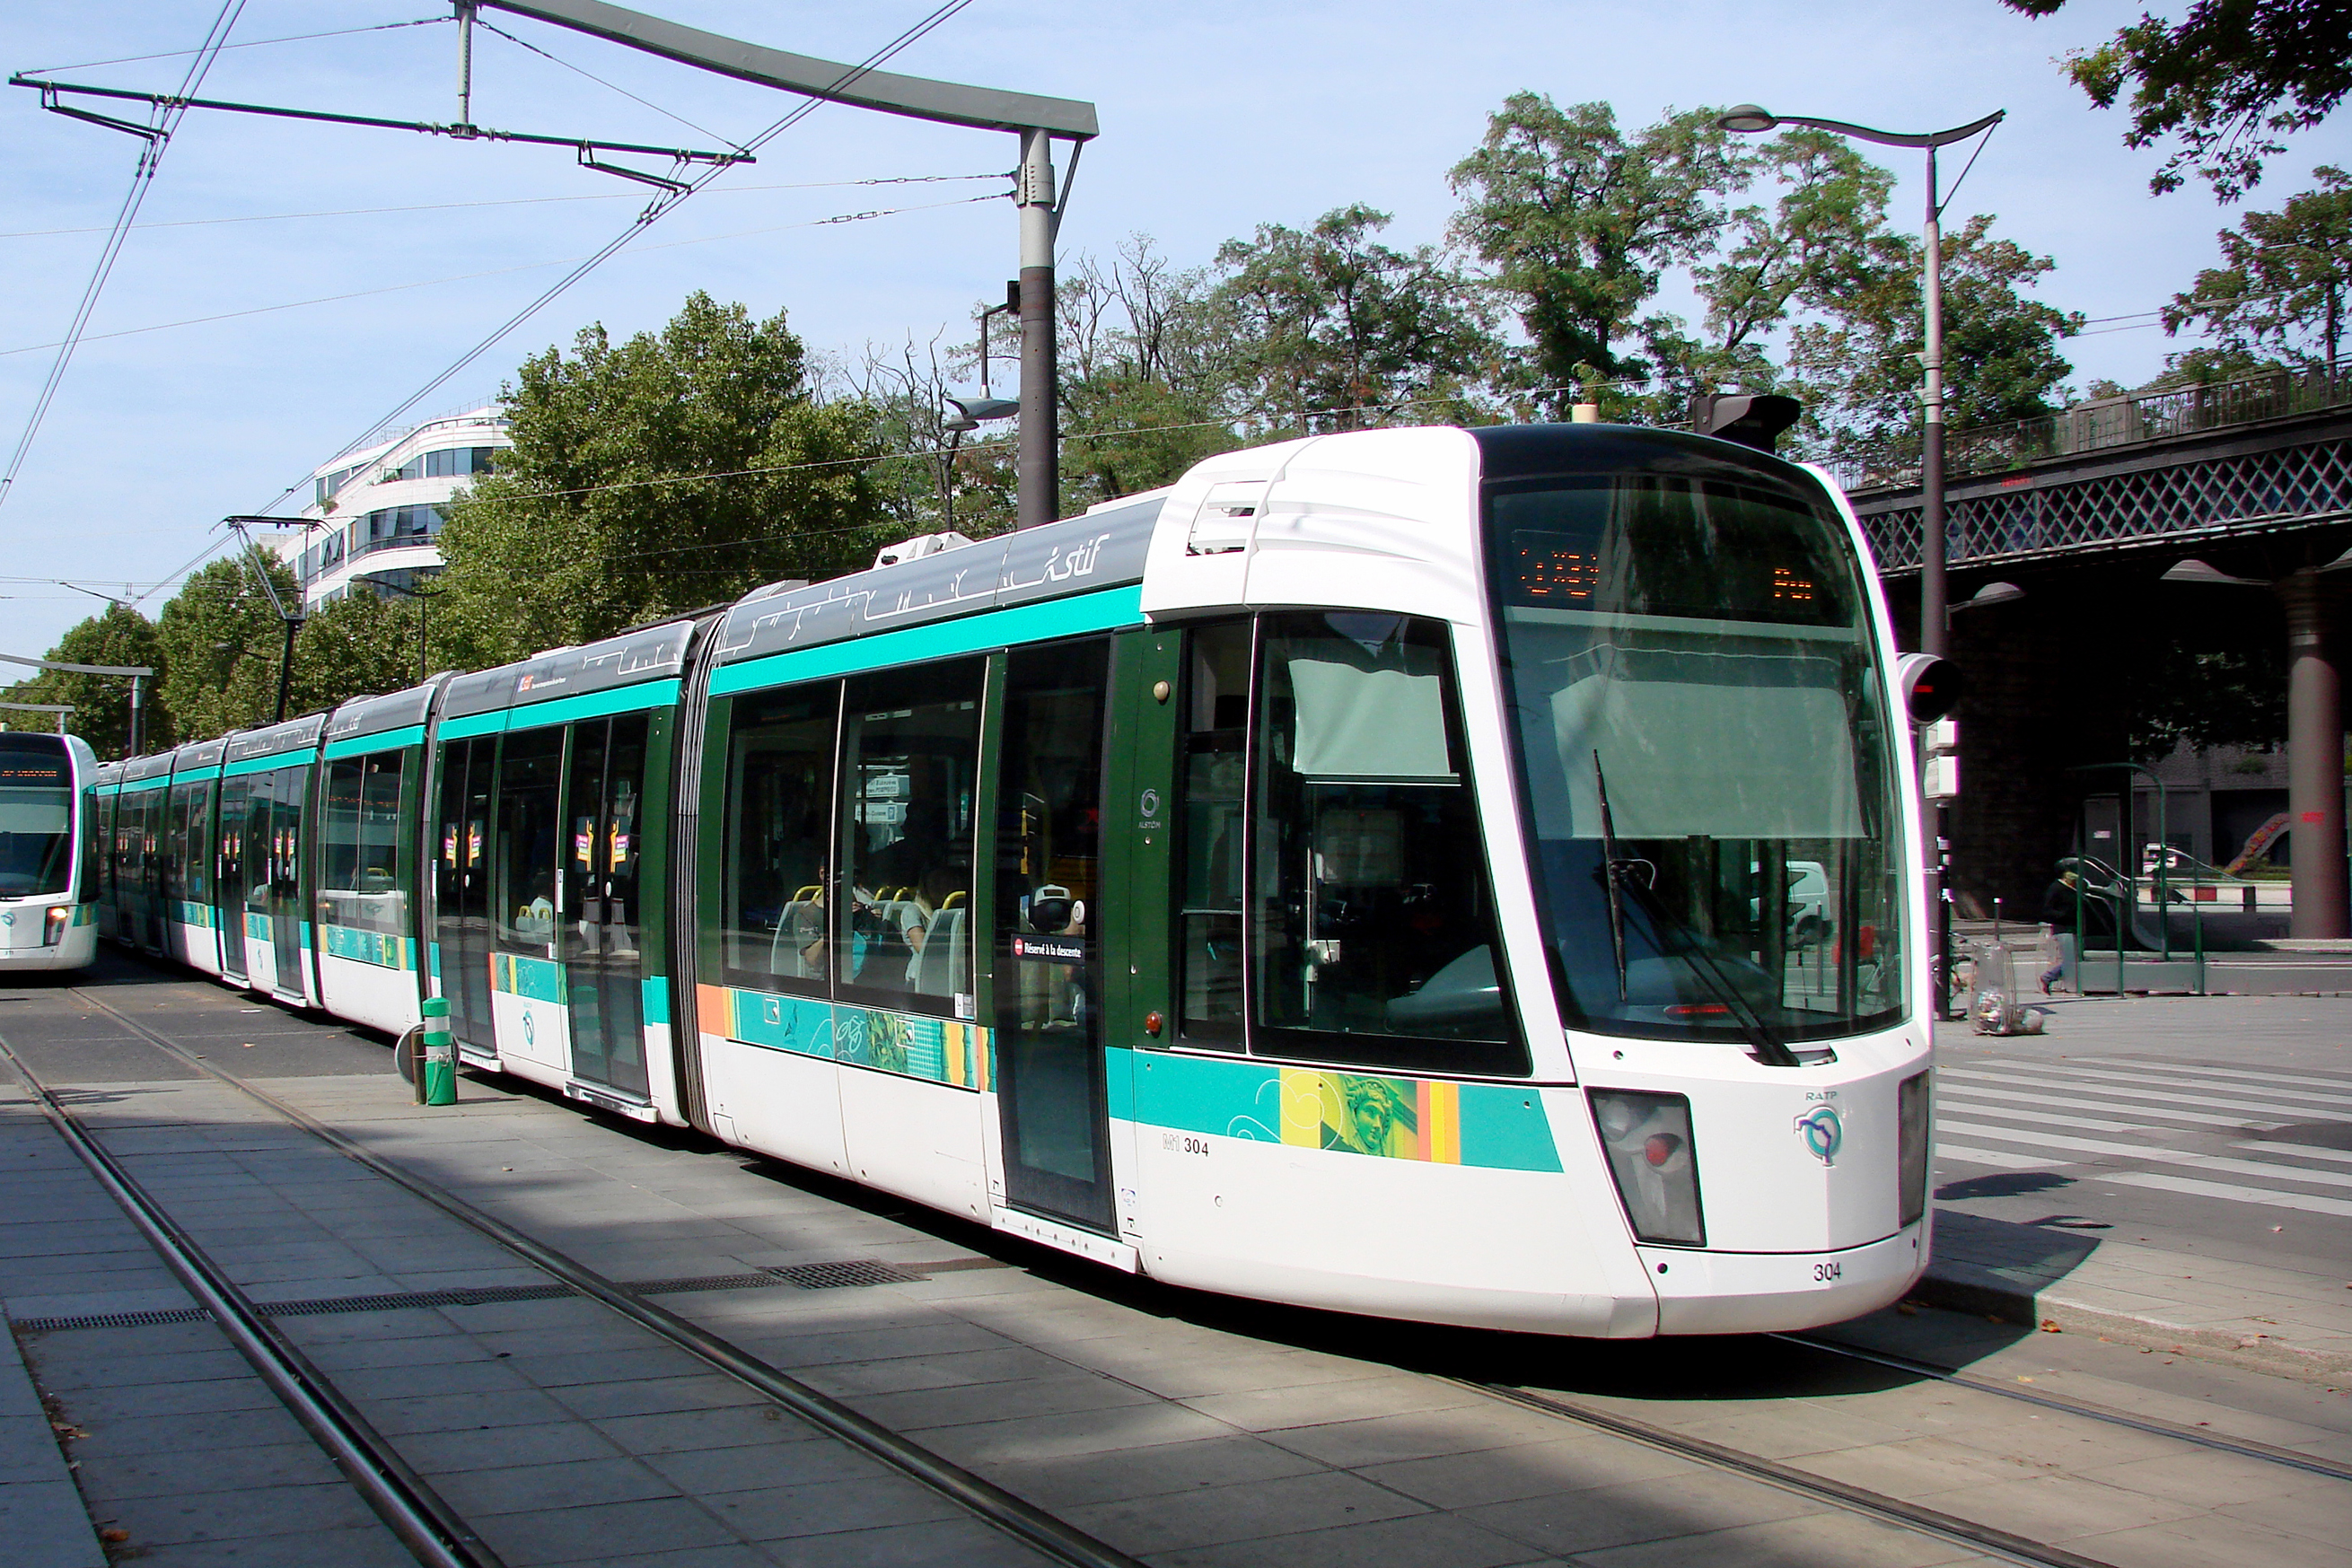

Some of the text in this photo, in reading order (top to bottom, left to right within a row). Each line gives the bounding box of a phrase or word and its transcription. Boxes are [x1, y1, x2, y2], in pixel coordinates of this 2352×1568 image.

[1024, 942, 1045, 955] Réservé
[1050, 943, 1057, 956] la
[1057, 944, 1082, 958] descente
[1804, 1091, 1838, 1101] RATP
[1183, 1136, 1209, 1158] 304
[1812, 1261, 1841, 1282] 304
